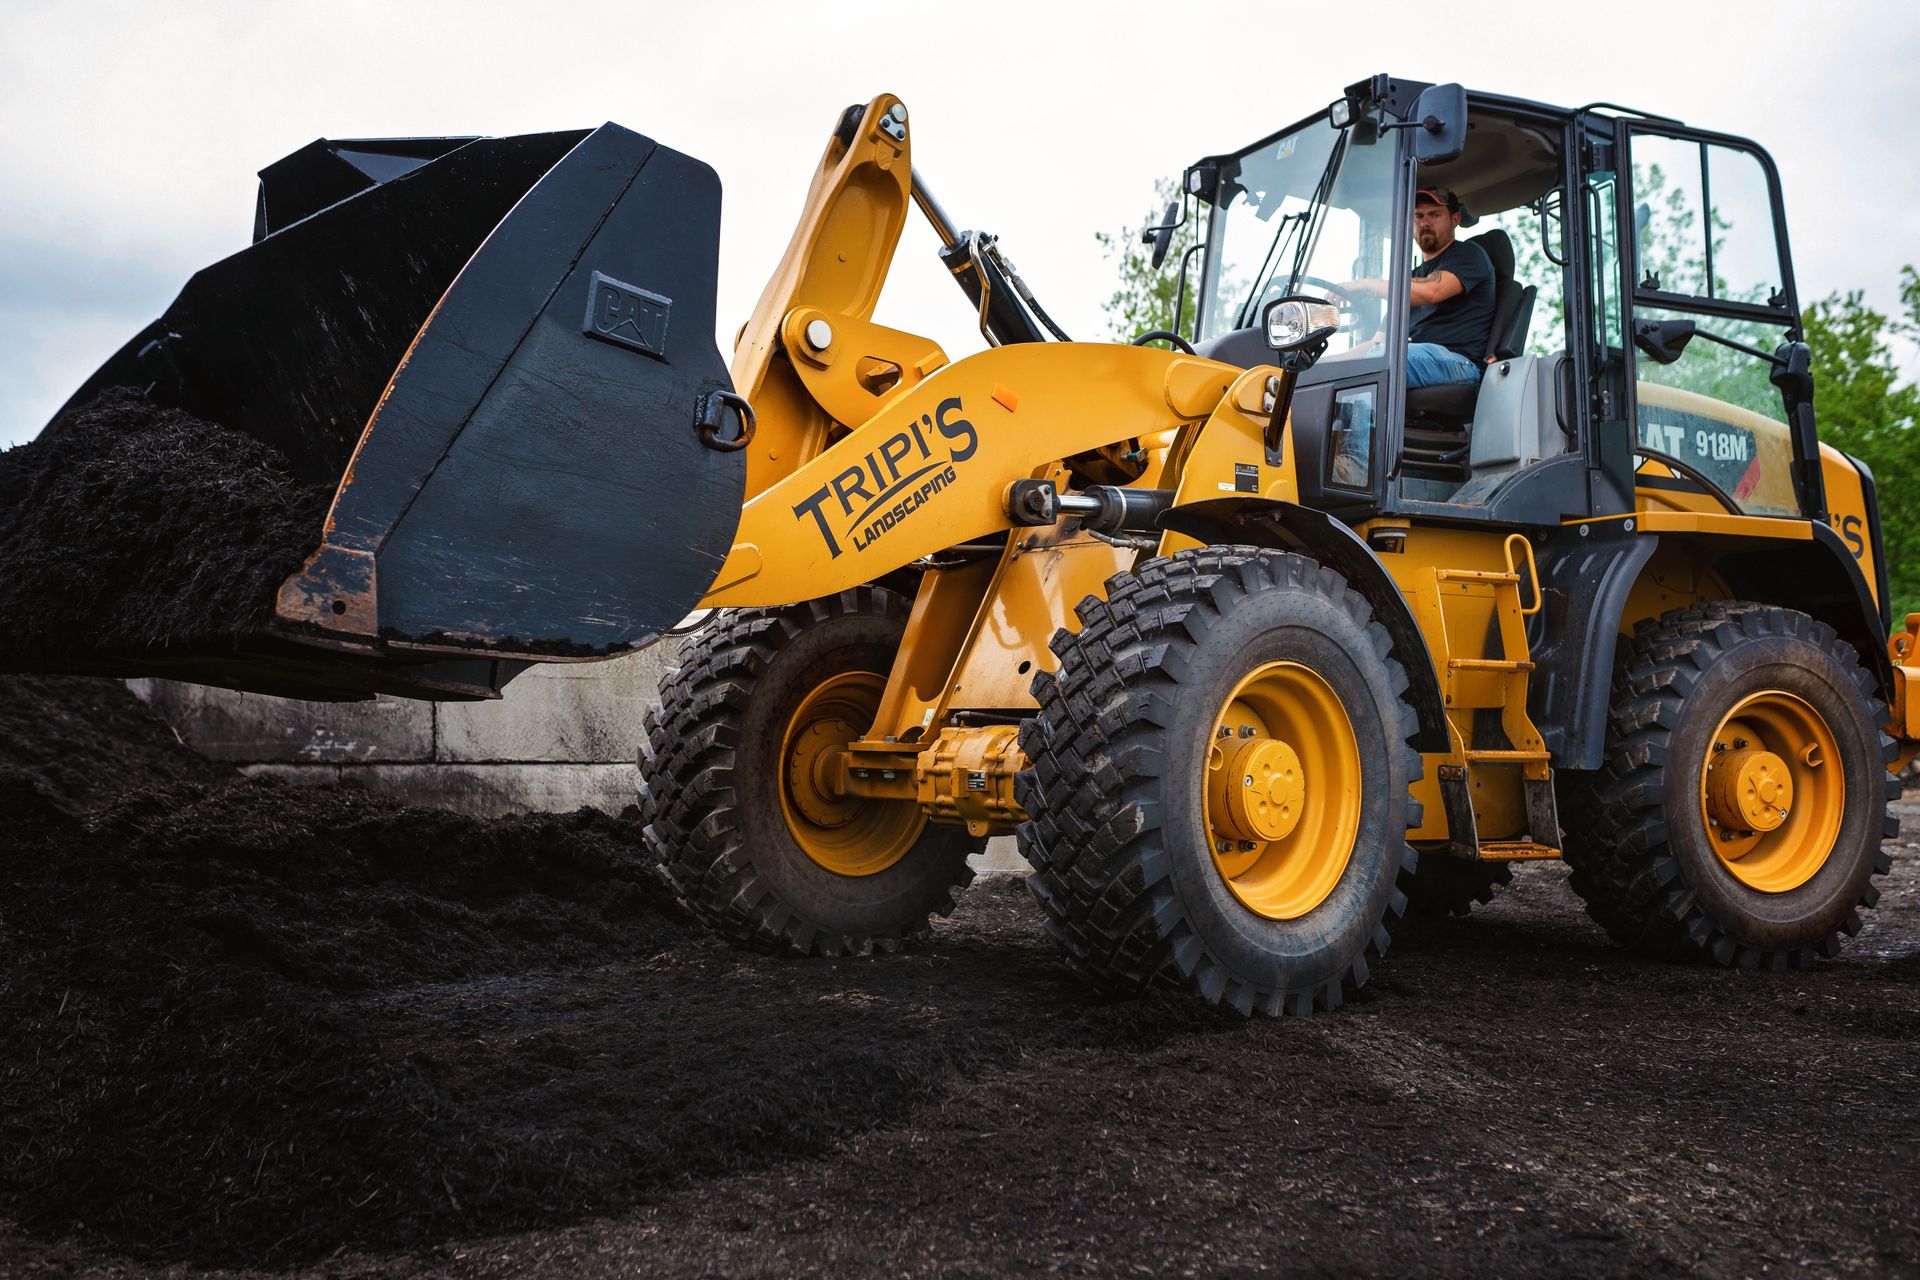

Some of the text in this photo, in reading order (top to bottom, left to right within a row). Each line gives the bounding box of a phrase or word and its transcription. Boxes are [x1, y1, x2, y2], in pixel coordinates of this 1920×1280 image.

[1277, 136, 1299, 161] CAT
[595, 286, 664, 349] CAT
[1696, 430, 1747, 461] 918M
[792, 396, 979, 560] TRIPI'S
[853, 465, 957, 552] LANDSCAPING
